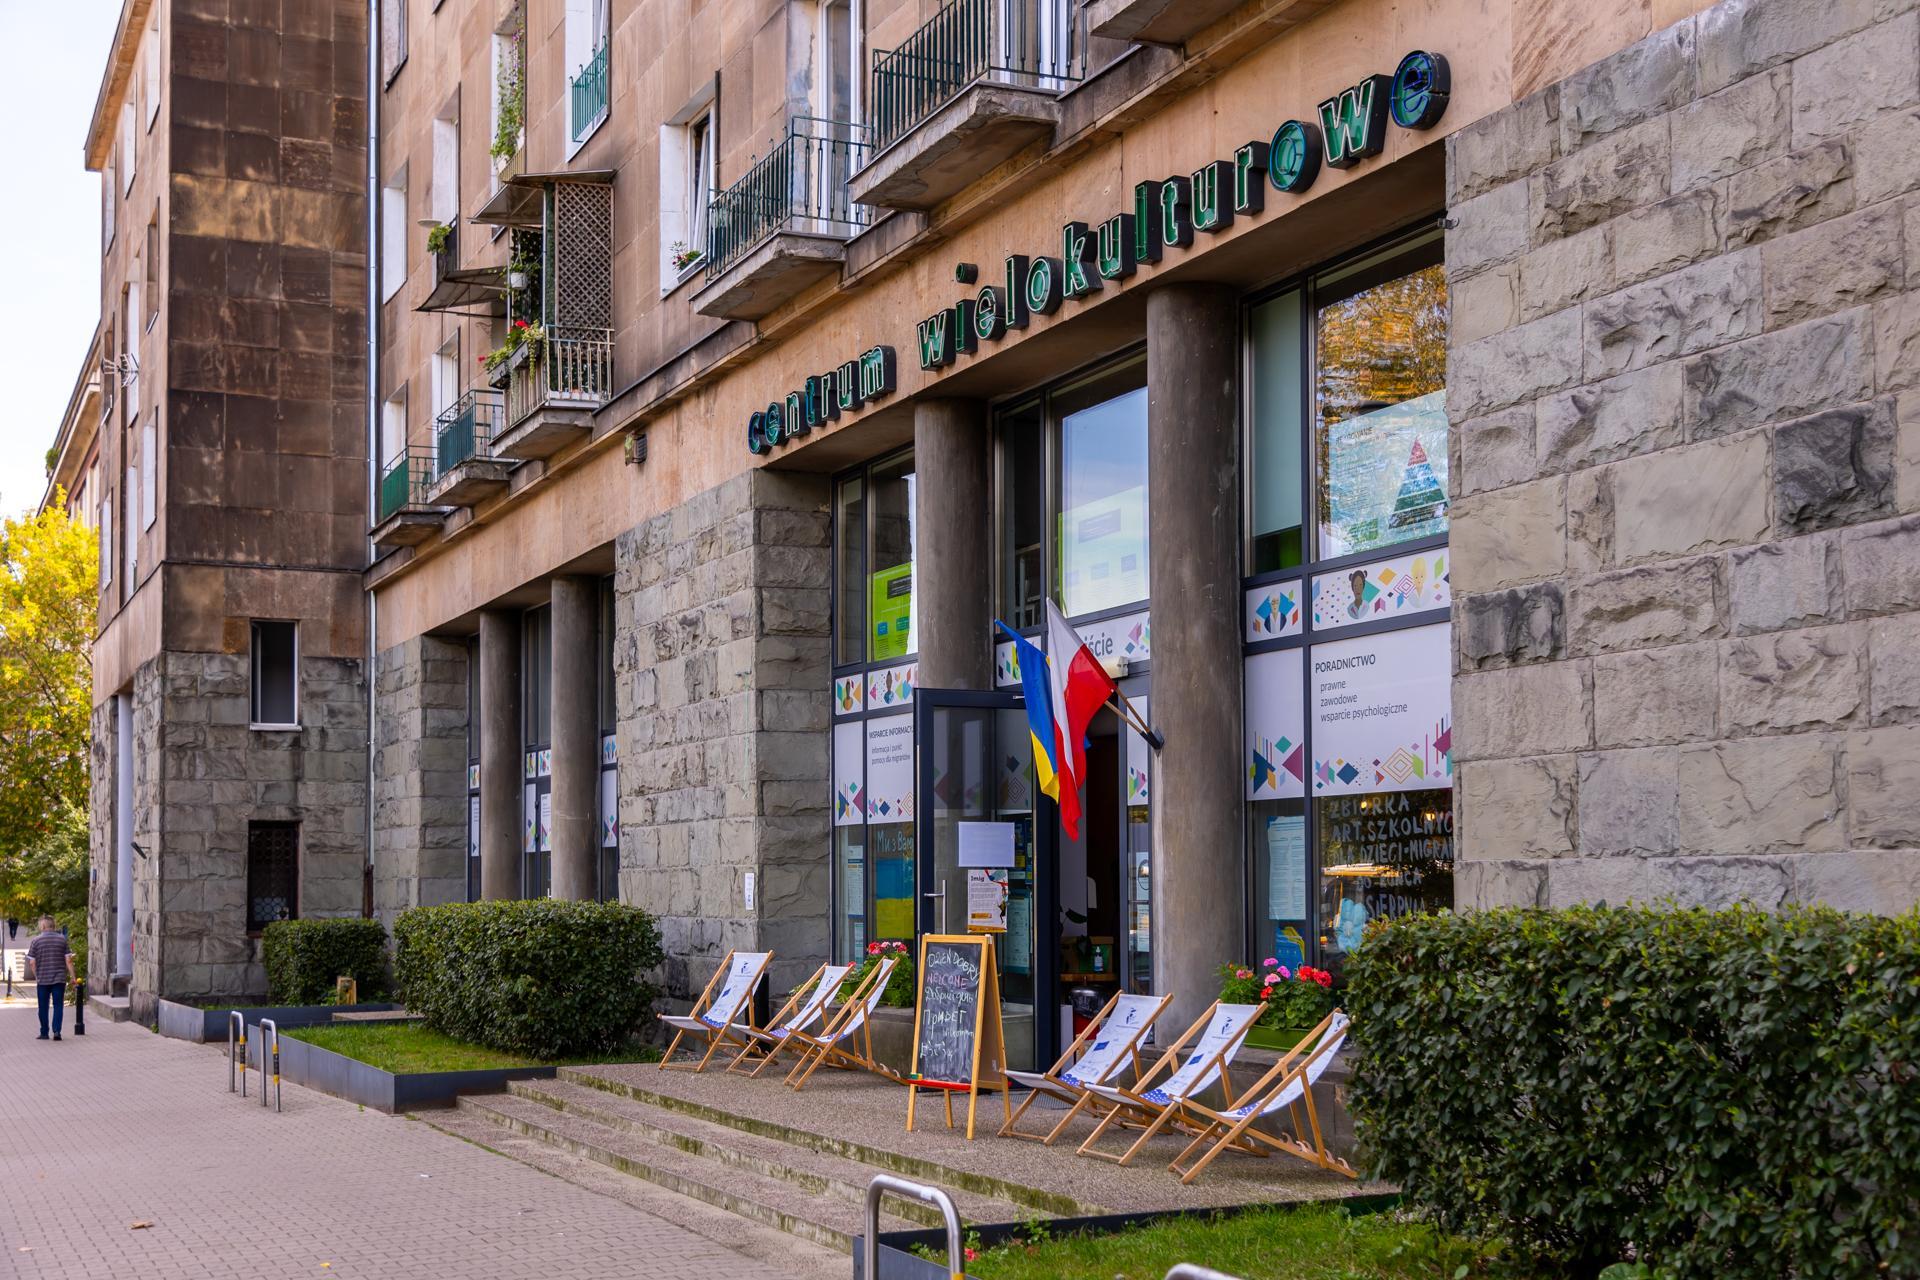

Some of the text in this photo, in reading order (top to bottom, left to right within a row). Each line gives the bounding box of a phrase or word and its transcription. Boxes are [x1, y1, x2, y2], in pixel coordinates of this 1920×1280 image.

[747, 50, 1451, 456] centrum wielokulturowe
[1084, 632, 1113, 657] ście
[1315, 654, 1376, 674] PORADNICTWO
[1320, 680, 1347, 694] prawne
[1320, 694, 1358, 707] zawodowe
[1320, 703, 1408, 723] wsparcie psychologiczne
[953, 952, 981, 985] DOBRY
